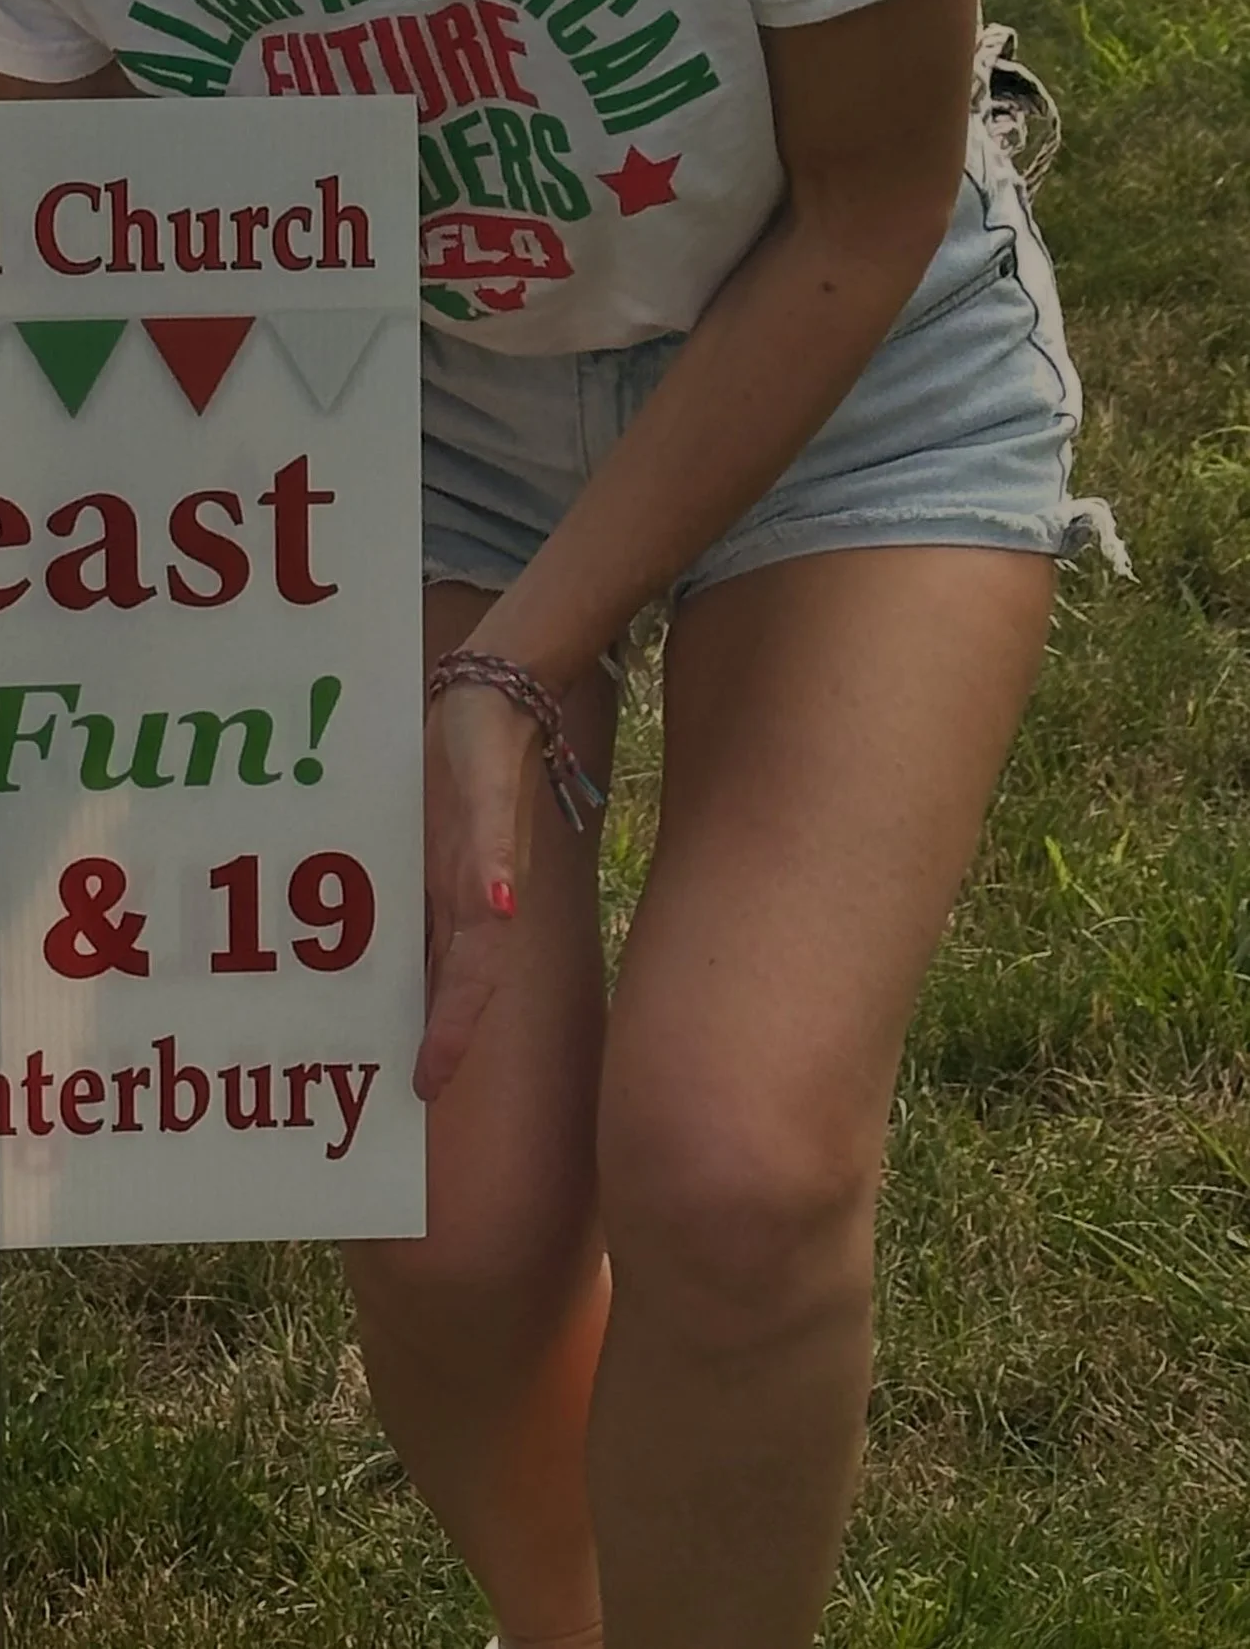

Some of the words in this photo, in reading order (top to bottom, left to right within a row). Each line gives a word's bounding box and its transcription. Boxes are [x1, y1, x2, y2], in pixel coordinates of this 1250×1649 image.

[419, 106, 592, 222] DERS
[35, 175, 375, 275] Church
[43, 858, 149, 979] &
[210, 852, 375, 973] 19
